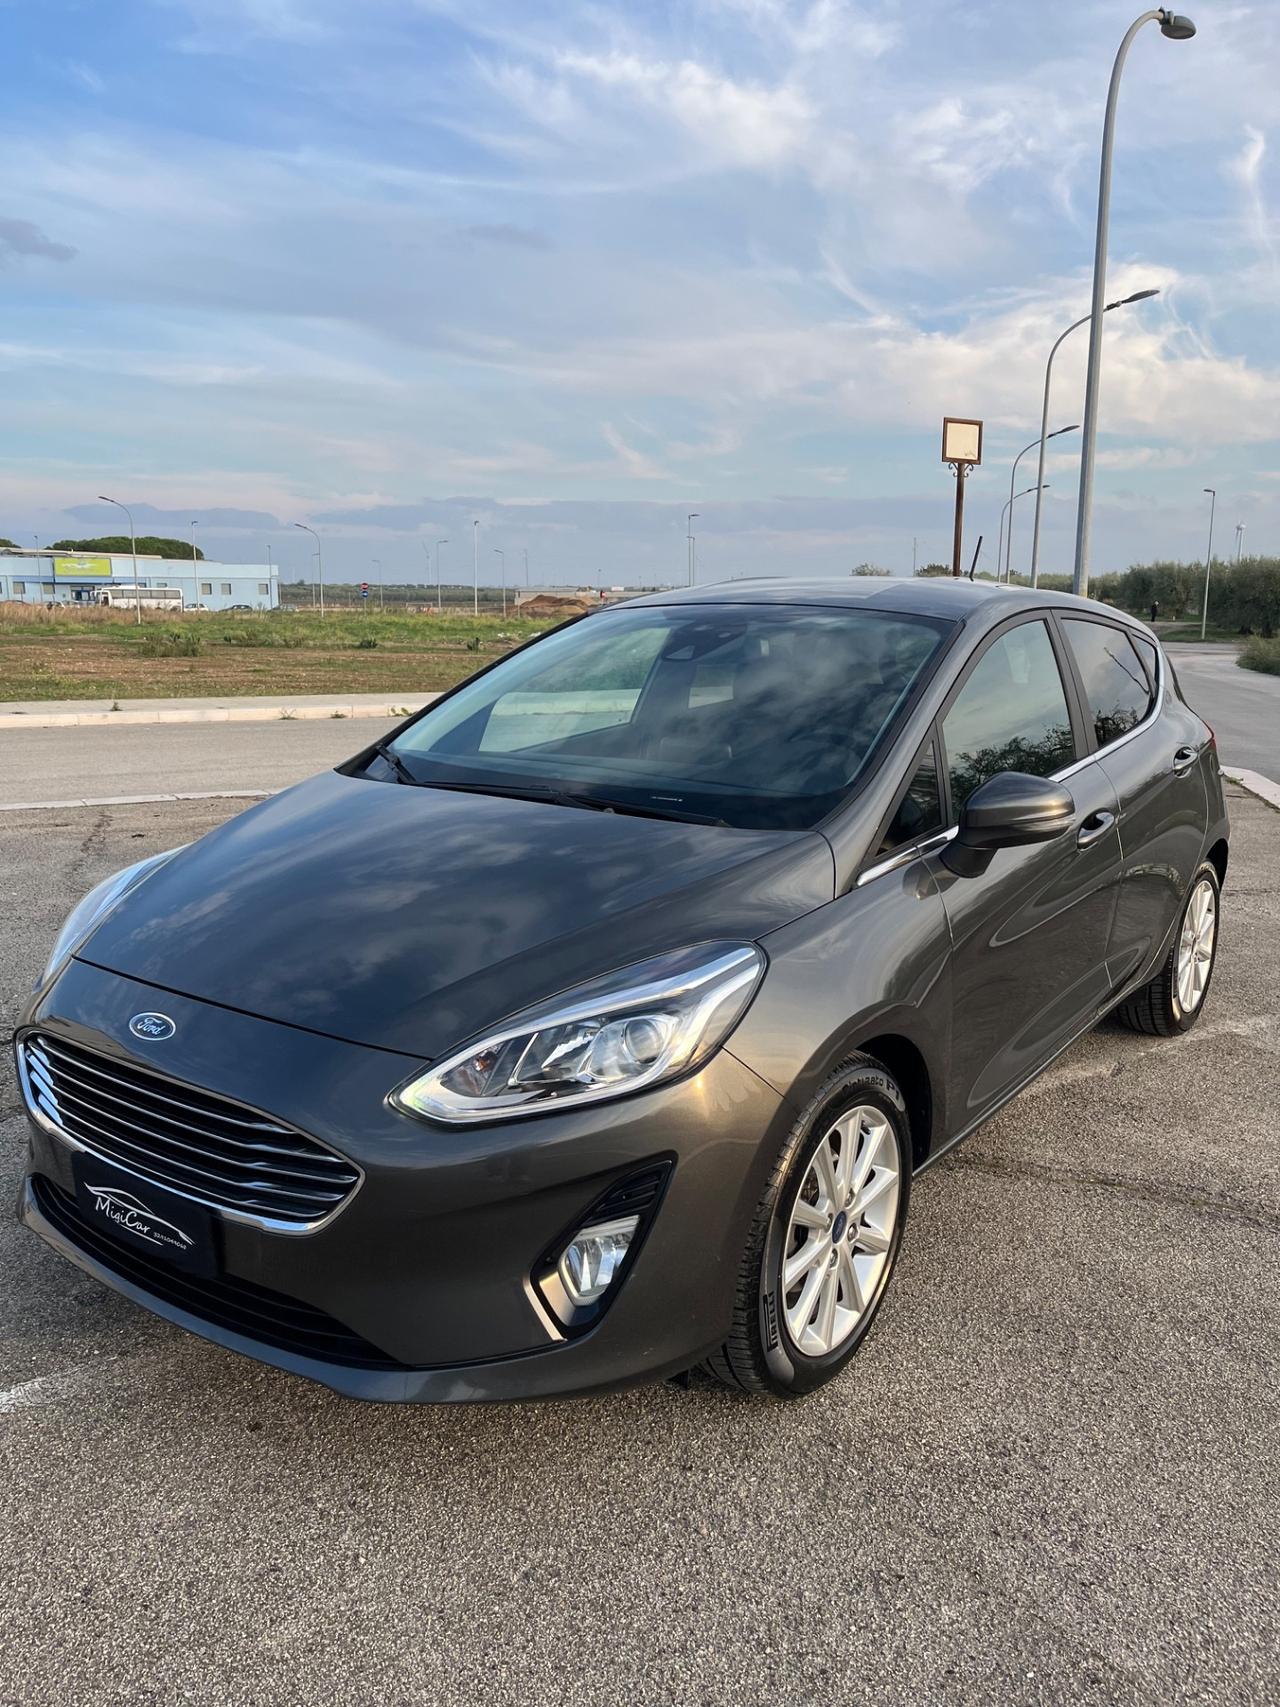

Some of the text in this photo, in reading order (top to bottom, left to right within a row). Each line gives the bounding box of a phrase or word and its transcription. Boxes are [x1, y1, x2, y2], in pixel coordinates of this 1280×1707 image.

[137, 1016, 166, 1035] Ford
[95, 1196, 151, 1233] MigiCar
[762, 1290, 779, 1353] PIRELLI
